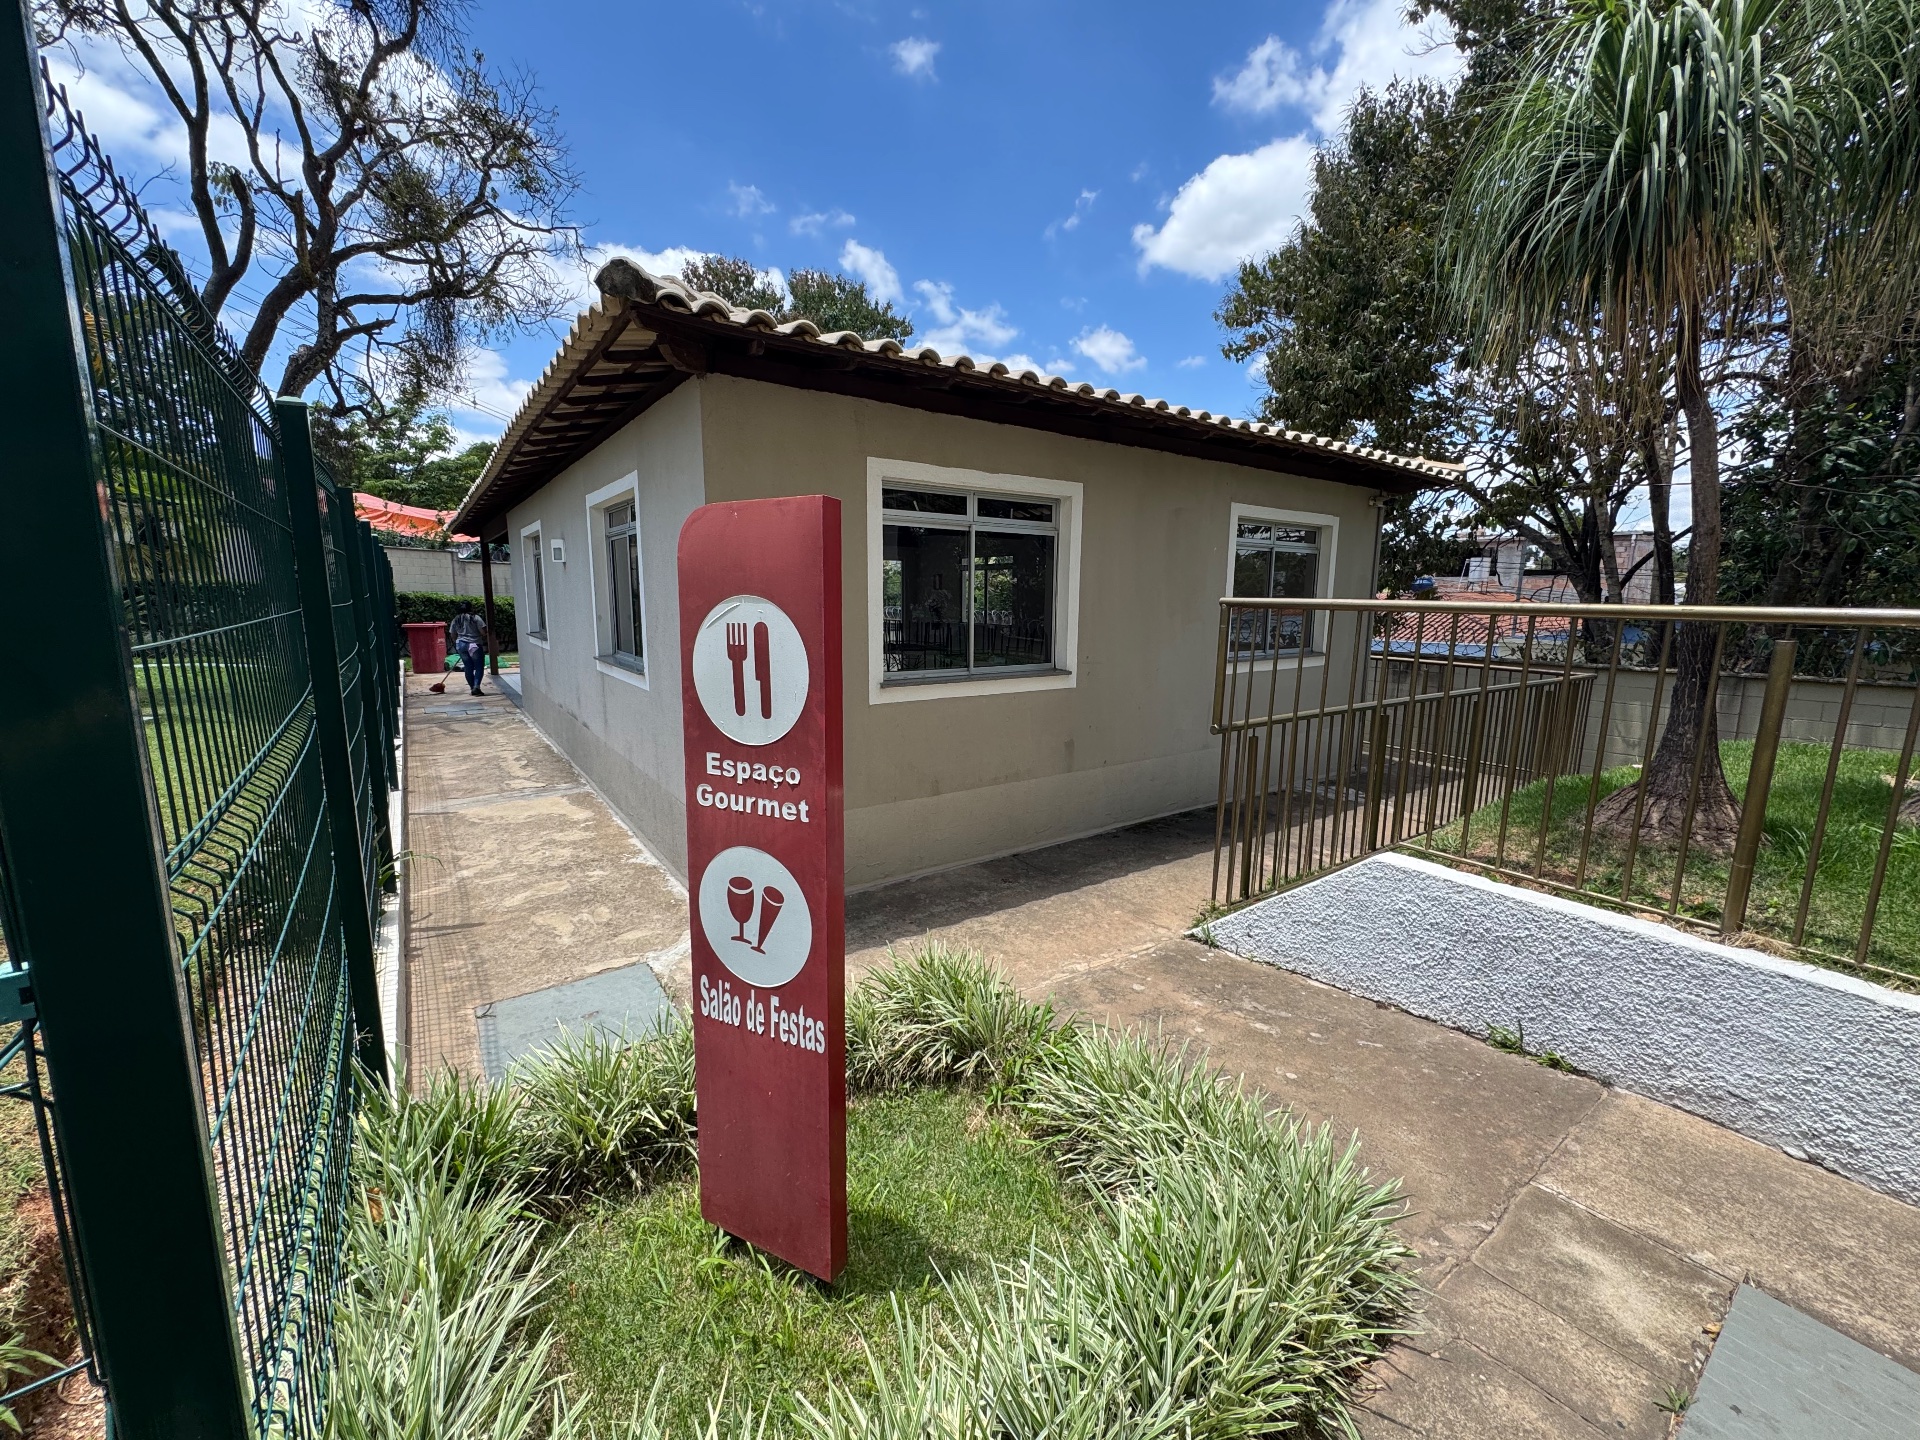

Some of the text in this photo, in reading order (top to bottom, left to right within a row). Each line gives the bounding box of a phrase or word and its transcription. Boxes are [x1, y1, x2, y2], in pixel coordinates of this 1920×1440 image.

[705, 751, 801, 789] Espaço
[696, 783, 810, 823] Gourmet
[700, 974, 826, 1054] Salão de Festas
